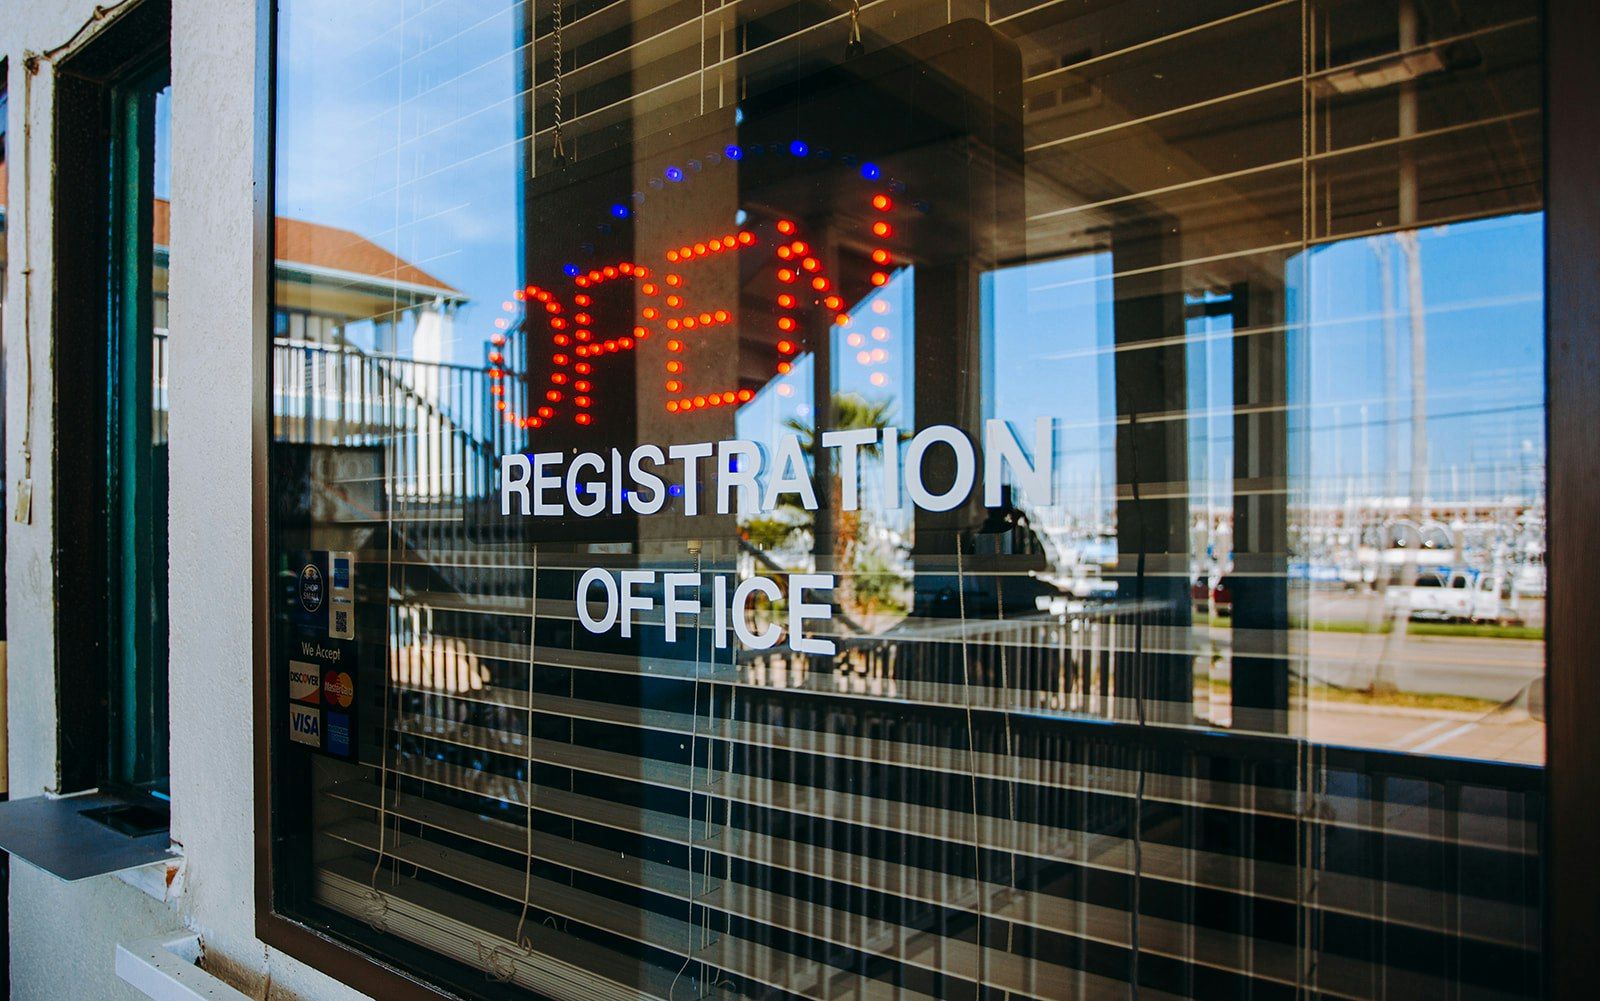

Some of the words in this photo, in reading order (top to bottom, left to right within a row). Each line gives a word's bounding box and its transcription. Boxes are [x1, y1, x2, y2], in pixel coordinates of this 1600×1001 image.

[488, 193, 893, 429] OPEN
[501, 416, 1055, 517] REGISTRATION
[576, 567, 836, 655] OFFICE
[290, 671, 319, 687] DISCOVER
[301, 641, 314, 656] We
[316, 644, 341, 663] Accept
[291, 711, 319, 737] VISA
